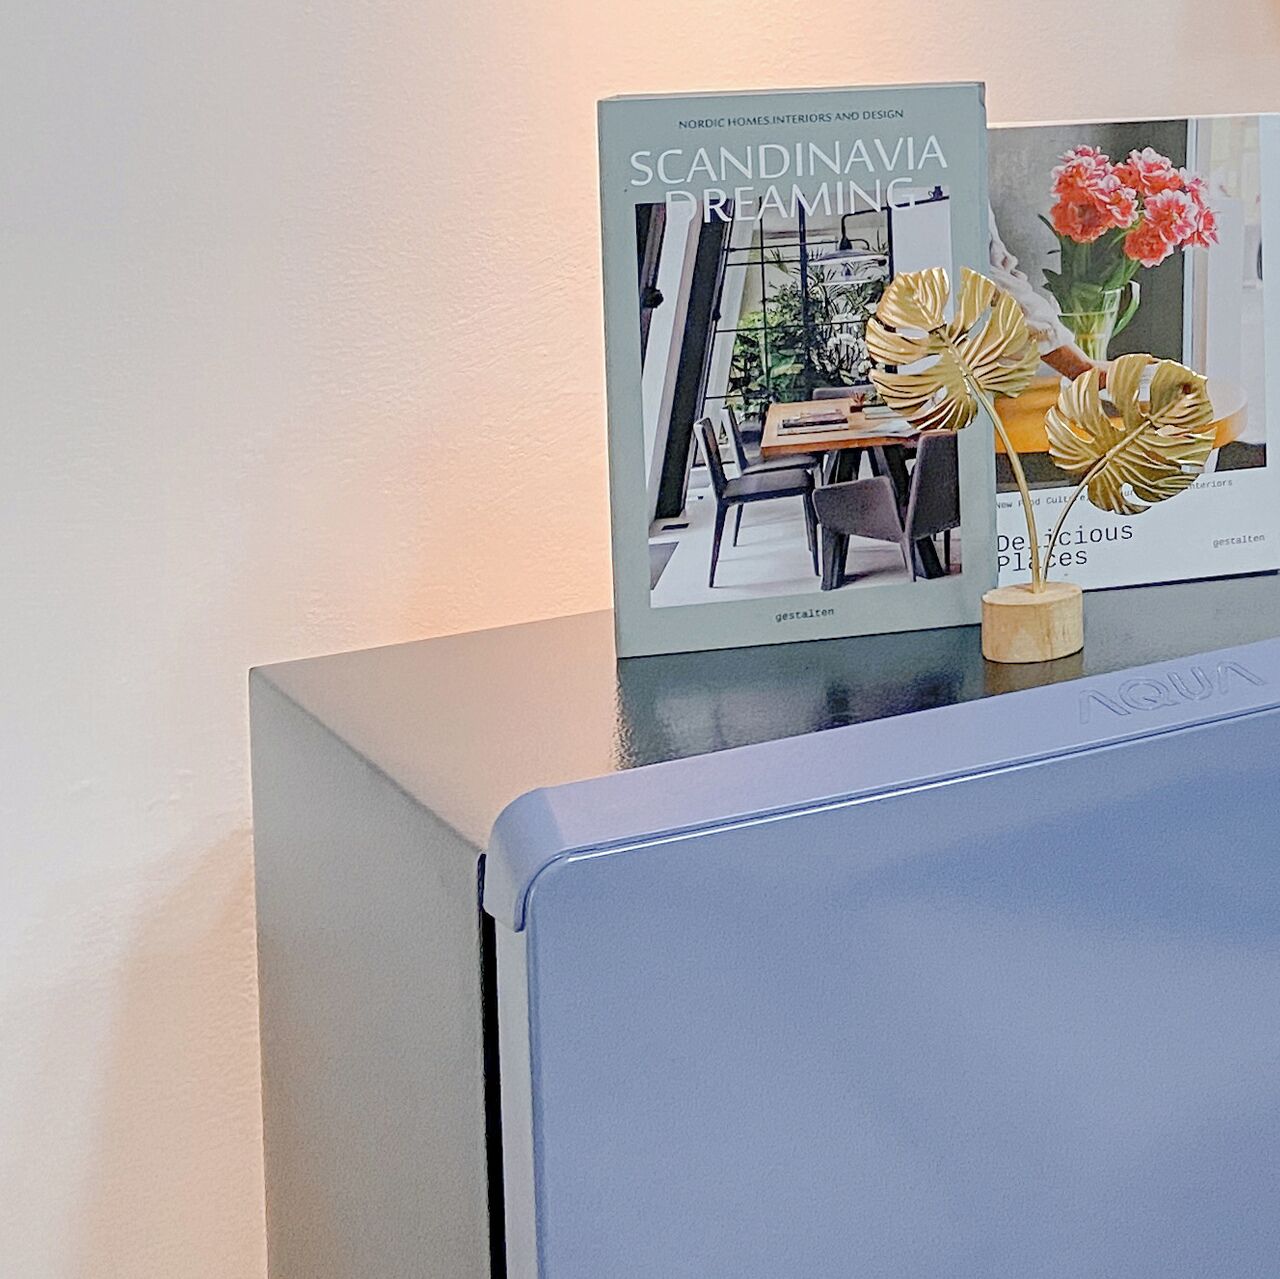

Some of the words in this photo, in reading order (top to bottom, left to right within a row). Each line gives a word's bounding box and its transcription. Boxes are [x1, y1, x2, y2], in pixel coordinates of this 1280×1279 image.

[678, 119, 725, 129] NORDIC
[772, 113, 832, 124] INTERIORS
[834, 111, 859, 121] AND
[862, 109, 904, 120] DESIGN
[630, 135, 948, 186] SCANDINAVIA
[665, 177, 915, 224] DREAMING
[997, 524, 1133, 552] Deicious
[1212, 533, 1266, 548] gestalten
[775, 608, 834, 623] gestalten
[1079, 660, 1266, 724] AQUA
